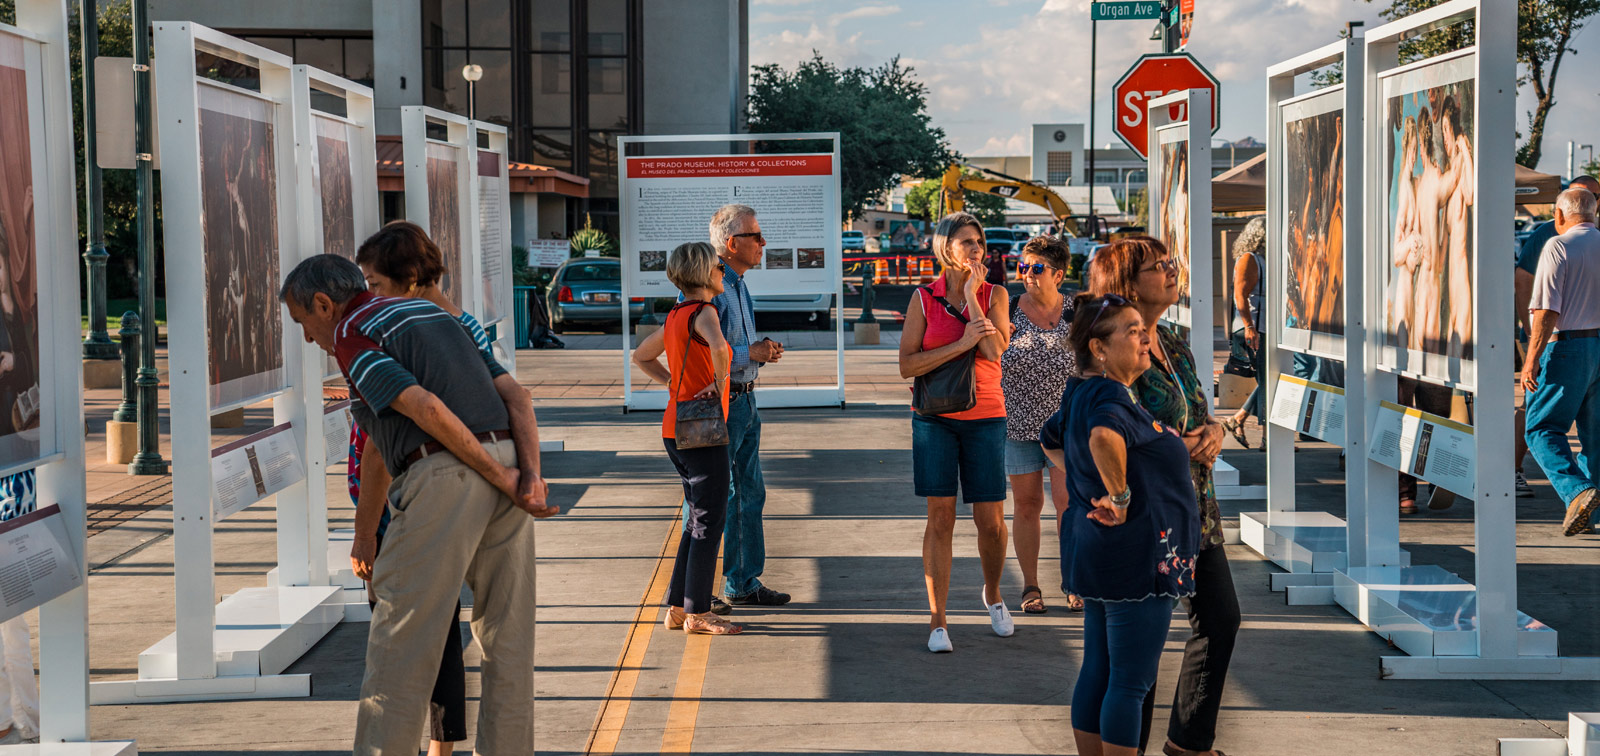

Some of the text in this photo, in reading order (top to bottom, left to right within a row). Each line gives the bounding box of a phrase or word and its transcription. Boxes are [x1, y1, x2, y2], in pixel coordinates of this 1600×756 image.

[1100, 2, 1153, 19] Organ Ave
[999, 186, 1013, 196] CAT
